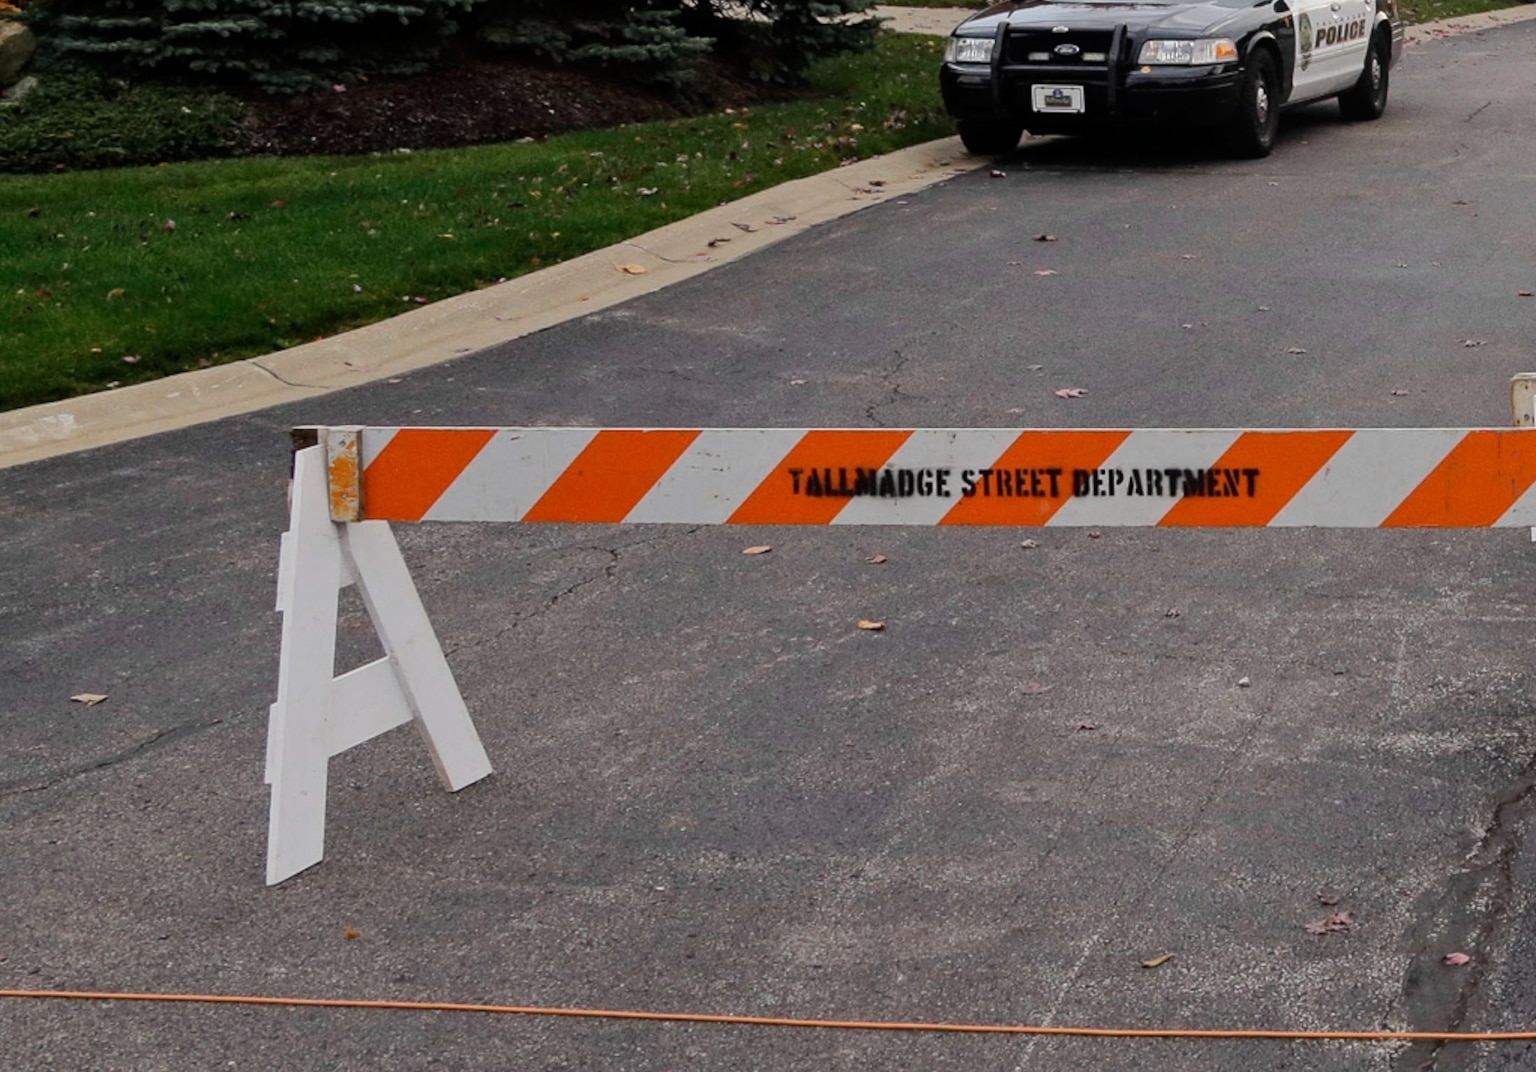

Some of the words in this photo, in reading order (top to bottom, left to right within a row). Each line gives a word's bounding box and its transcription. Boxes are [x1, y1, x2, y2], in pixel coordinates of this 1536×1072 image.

[1315, 19, 1367, 48] POLICE
[788, 467, 951, 498] TALLMADGE
[961, 468, 1062, 497] STREET
[1072, 468, 1260, 498] DEPARTMENT
